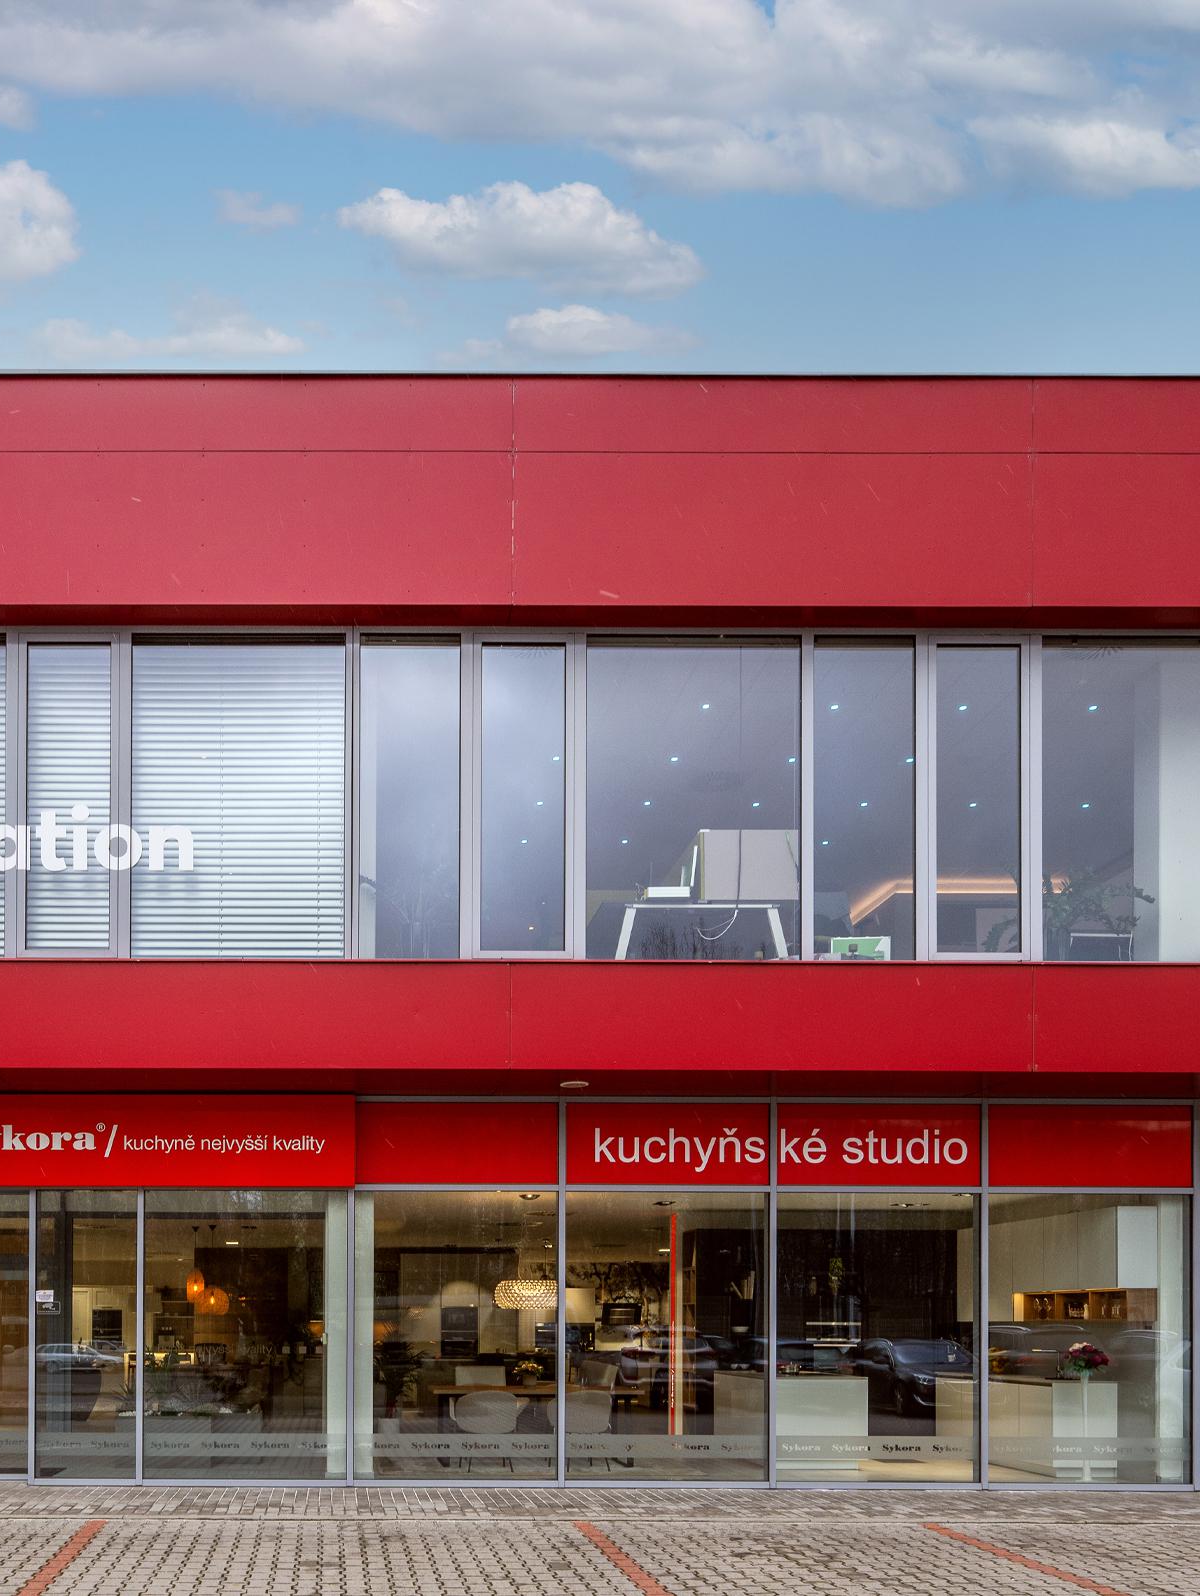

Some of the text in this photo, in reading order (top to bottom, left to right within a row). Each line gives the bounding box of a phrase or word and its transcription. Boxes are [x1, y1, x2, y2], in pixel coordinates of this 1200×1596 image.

[123, 1135, 196, 1153] kuchyně
[201, 1135, 268, 1154] nejvyšší
[272, 1135, 326, 1154] kvality
[842, 1129, 969, 1165] studio
[411, 1442, 450, 1451] Sykora
[461, 1442, 500, 1451] Sykora
[511, 1442, 550, 1451] Sykora
[782, 1443, 821, 1453] Sykora
[832, 1443, 871, 1453] Sykora
[882, 1443, 921, 1453] Sykora
